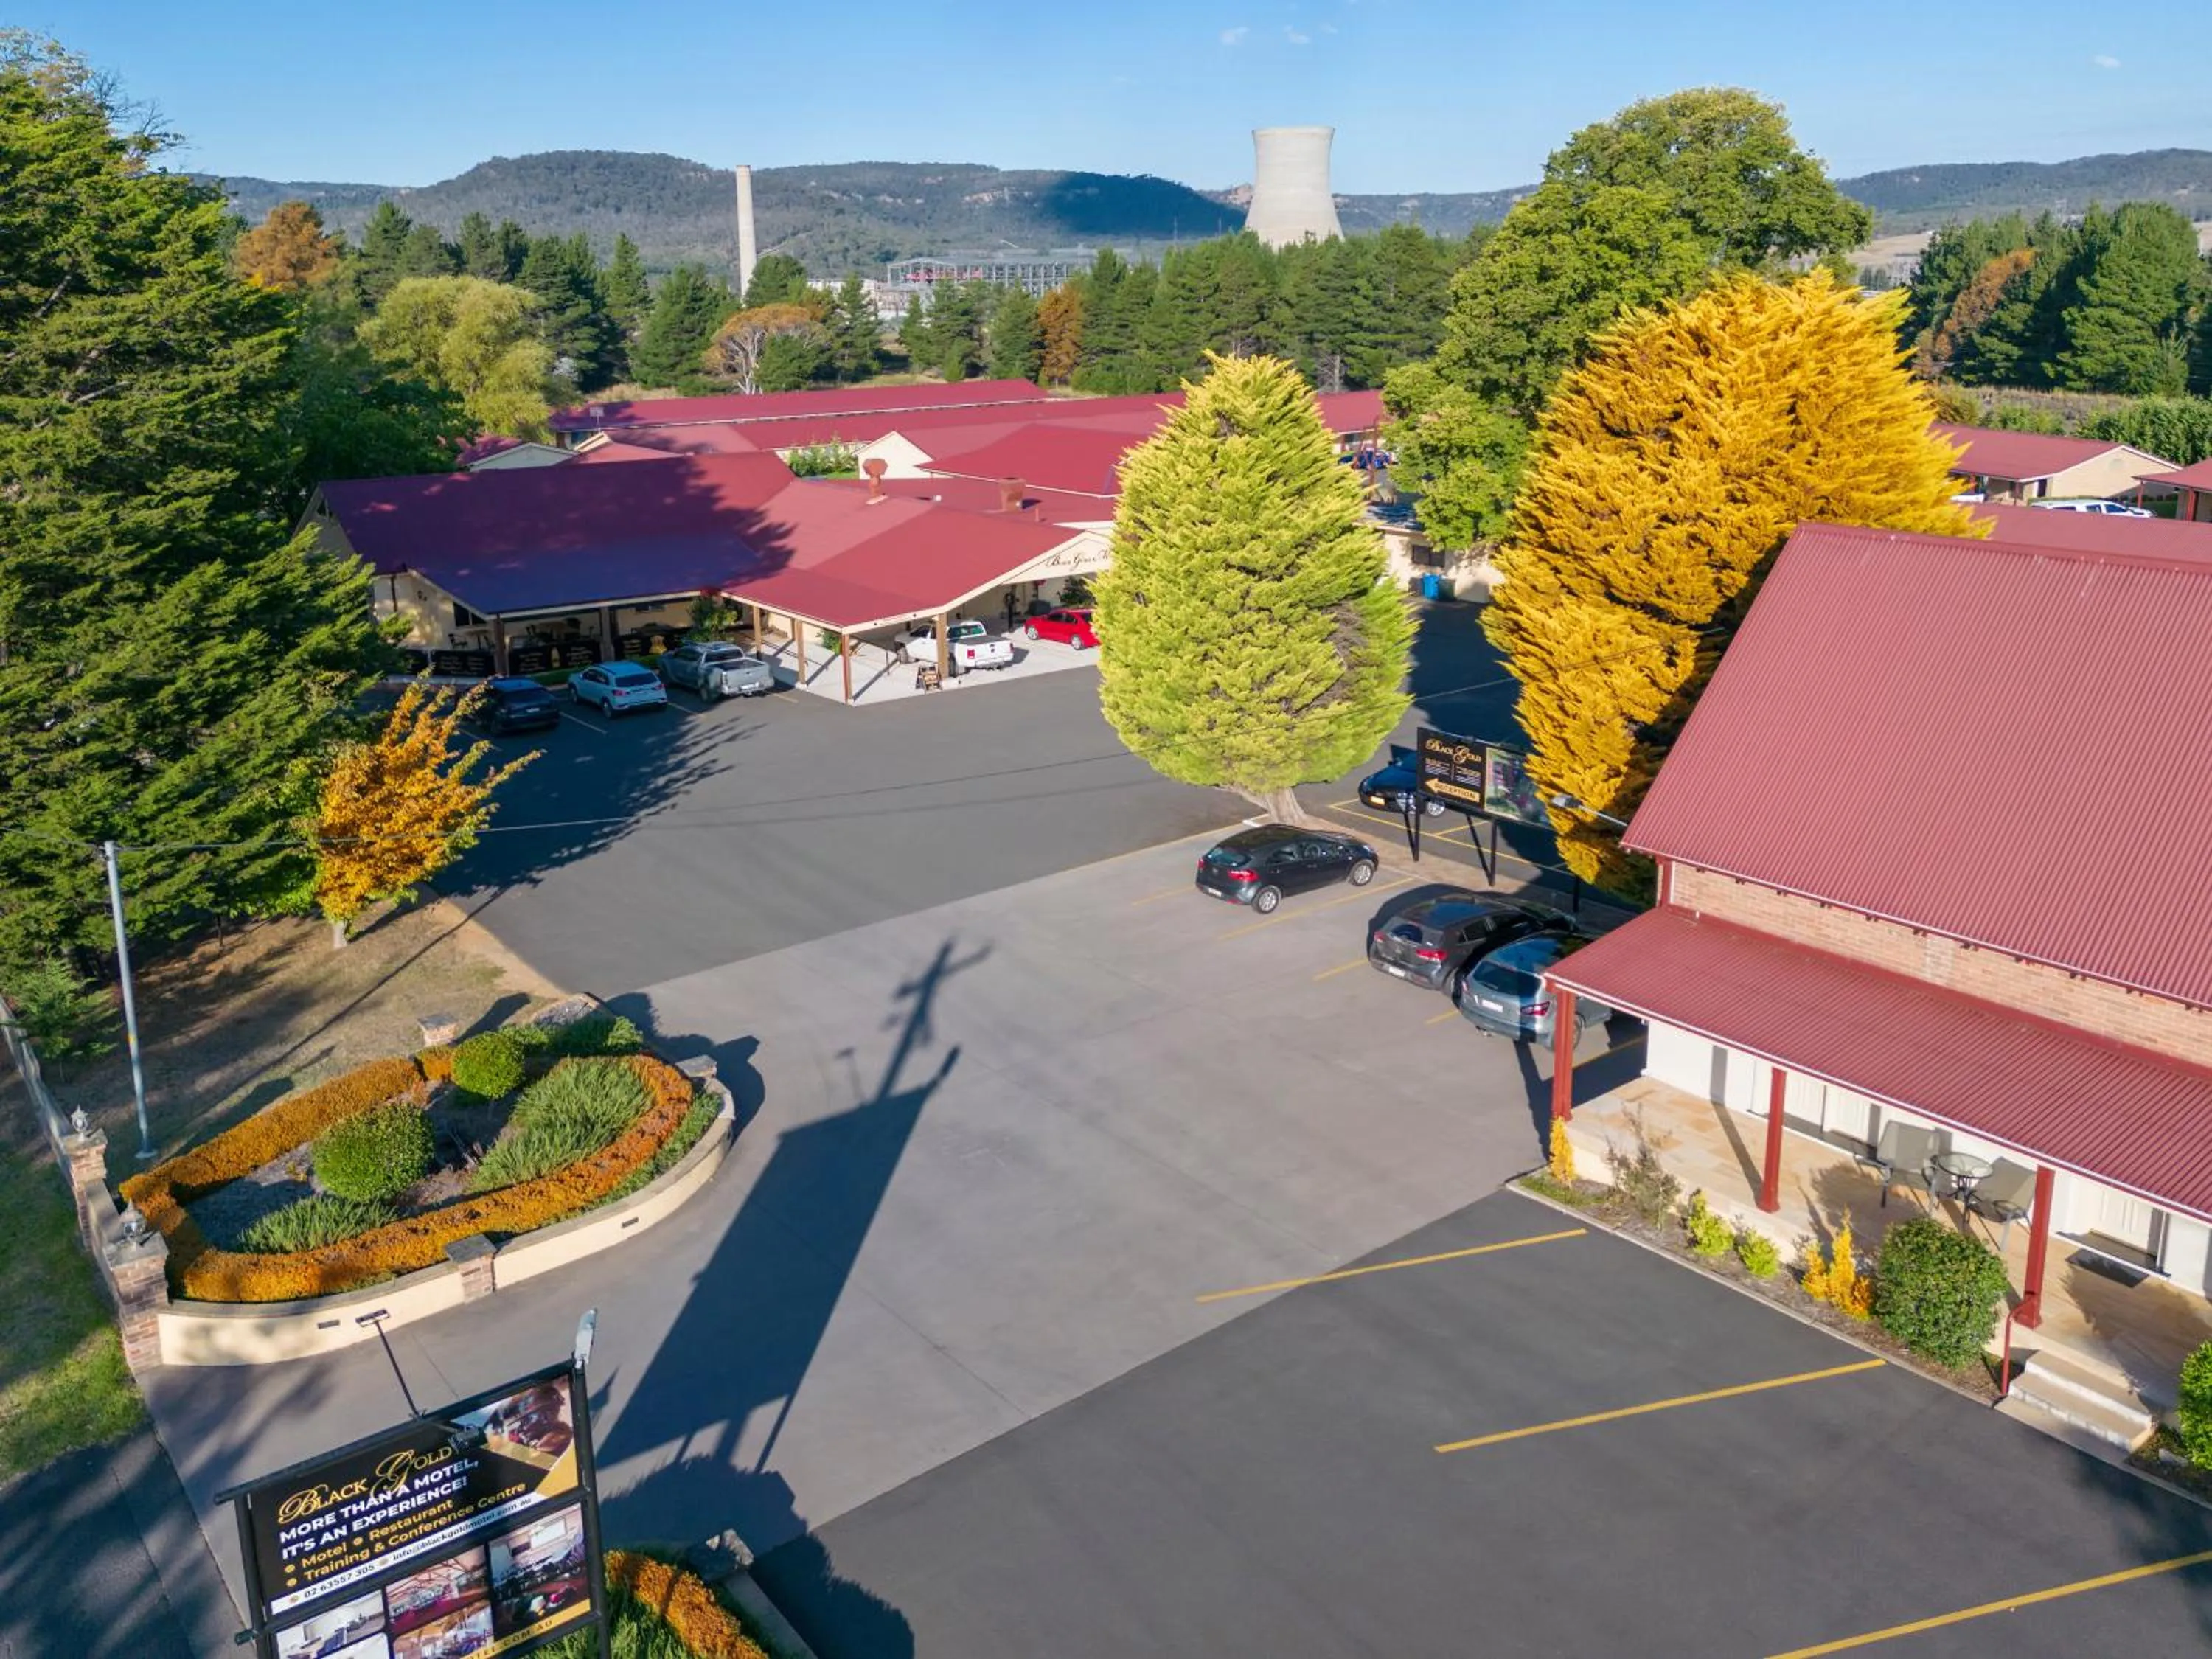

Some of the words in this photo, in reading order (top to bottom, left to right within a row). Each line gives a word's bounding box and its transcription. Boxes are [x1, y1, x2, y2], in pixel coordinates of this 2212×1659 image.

[278, 1478, 368, 1524] BLACK
[279, 1512, 337, 1543] MORE
[340, 1489, 392, 1518] THAN
[395, 1484, 411, 1498] A
[413, 1458, 479, 1489] MOTEL,
[282, 1536, 316, 1559] IT'S
[320, 1525, 347, 1545] AN
[352, 1476, 467, 1531] EXPERIENCE!
[301, 1542, 347, 1568] Motel
[369, 1499, 453, 1541] Restaurant
[304, 1548, 370, 1581] Training
[374, 1543, 386, 1553] &
[388, 1504, 474, 1545] Conference
[478, 1483, 526, 1508] Centre
[304, 1588, 318, 1599] 02
